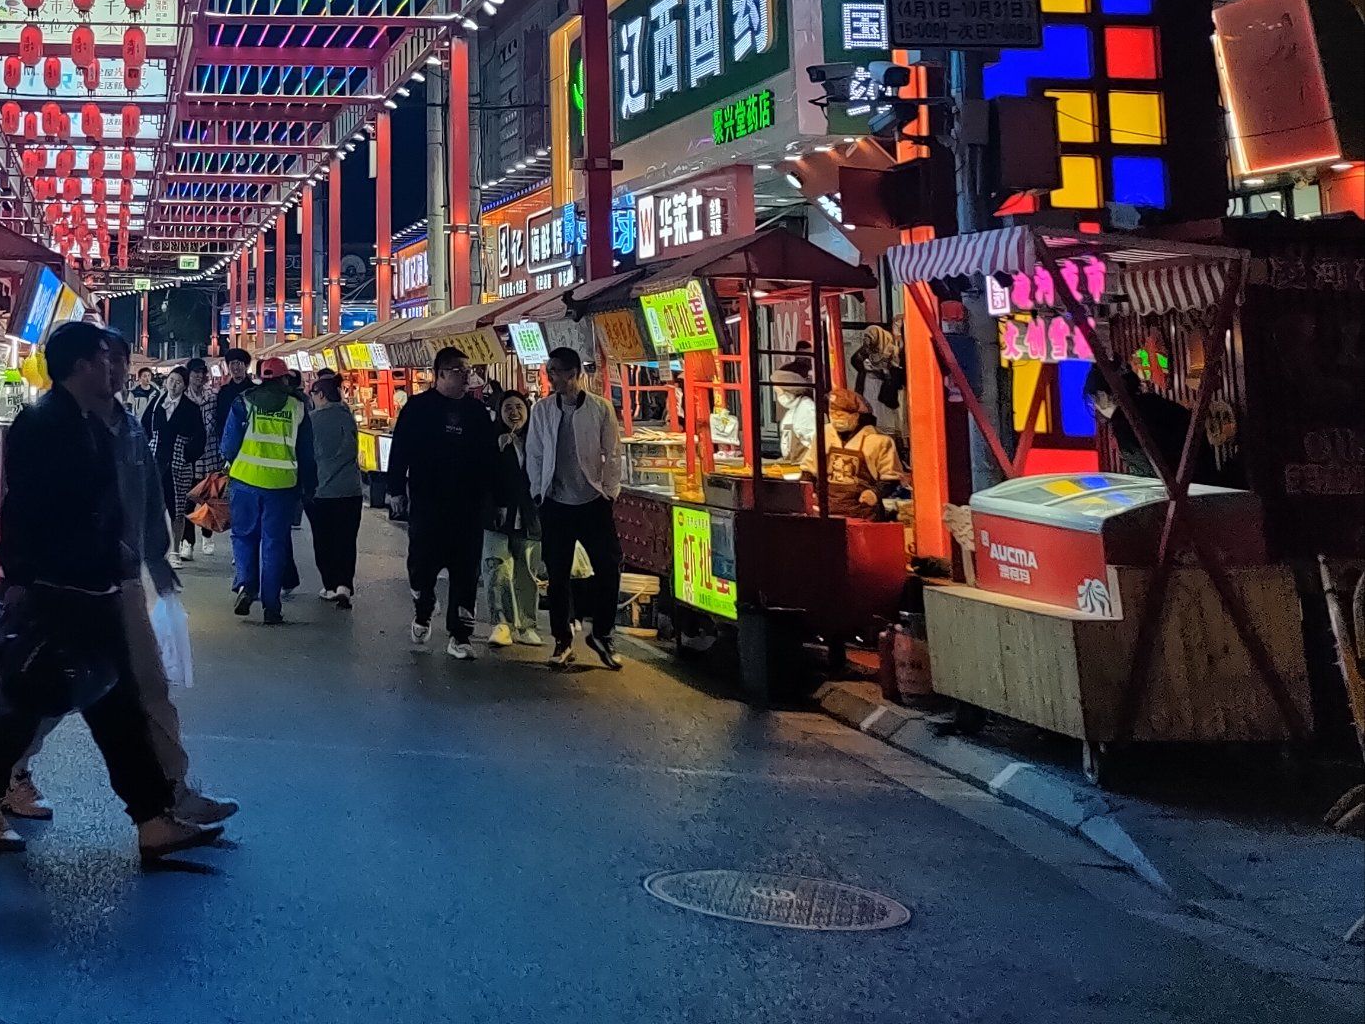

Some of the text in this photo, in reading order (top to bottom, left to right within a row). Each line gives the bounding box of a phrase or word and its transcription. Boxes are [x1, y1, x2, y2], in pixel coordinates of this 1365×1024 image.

[640, 206, 653, 248] W
[658, 188, 704, 248] 华莱士
[990, 542, 1039, 570] AUCMA
